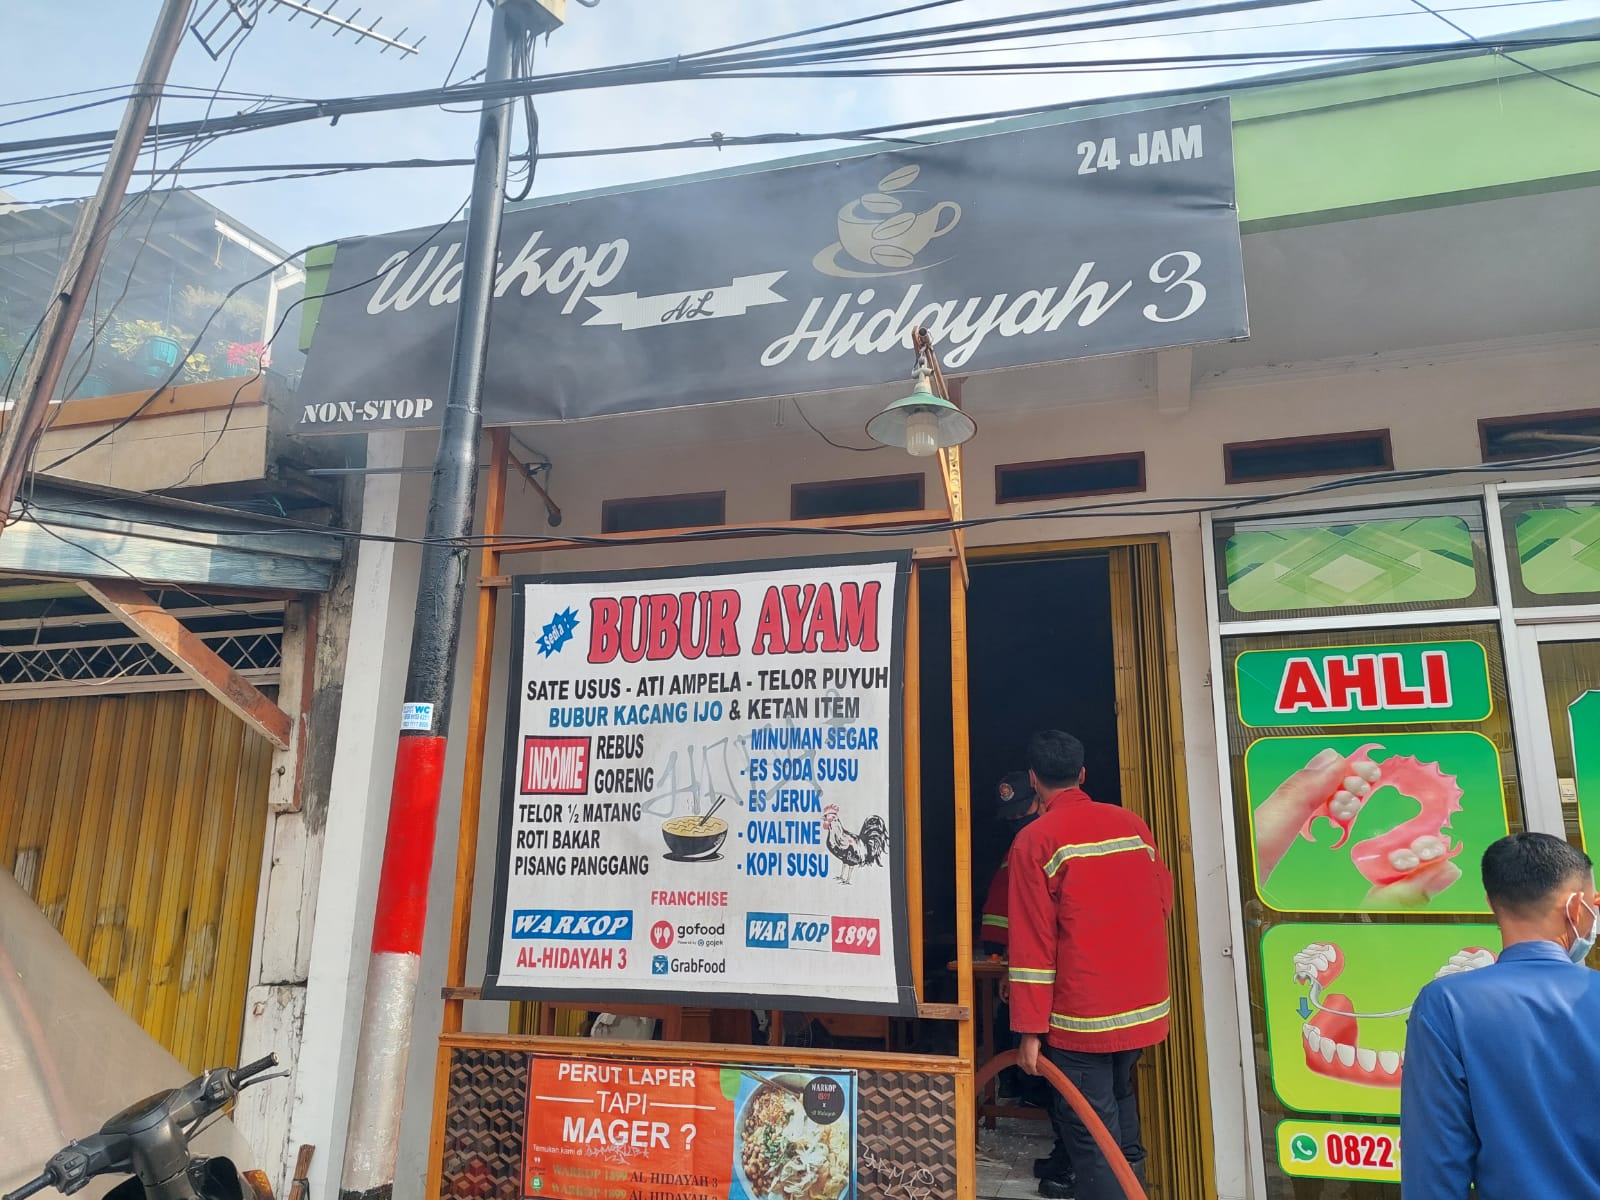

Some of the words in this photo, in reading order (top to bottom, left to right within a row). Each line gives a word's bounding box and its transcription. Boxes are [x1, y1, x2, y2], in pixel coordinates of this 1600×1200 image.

[1077, 140, 1120, 175] 24
[1130, 124, 1203, 167] JAM
[366, 231, 630, 315] Wakop
[661, 290, 714, 324] AL
[760, 262, 1133, 368] Hidayah
[1143, 250, 1207, 323] 3
[300, 398, 432, 423] NON-STOP
[587, 590, 741, 664] BUBUR
[751, 580, 882, 656] AYAM
[527, 680, 569, 700] SATE
[574, 678, 621, 699] USUS
[636, 676, 664, 697] ATI
[669, 672, 742, 696] AMPELA
[758, 668, 817, 691] TELOR
[822, 667, 888, 689] PUYUH
[1276, 652, 1452, 713] AHLI
[415, 705, 430, 714] WC
[549, 706, 608, 728] BUBUR
[614, 702, 688, 726] KACANG
[693, 700, 723, 722] IJO
[729, 699, 741, 721] &
[748, 697, 807, 720] KETAN
[814, 697, 860, 719] ITEM
[596, 734, 644, 760] REBUS
[751, 727, 822, 750] MINUMAN
[827, 727, 878, 750] SEGAR
[528, 746, 584, 791] INDOMIE
[595, 767, 654, 793] GORENG
[749, 758, 768, 781] ES
[772, 758, 813, 781] SODA
[817, 758, 859, 782] SUSU
[519, 804, 563, 823] TELOR
[583, 802, 641, 822] MATANG
[749, 789, 766, 812] ES
[772, 789, 822, 812] JERUK
[516, 830, 548, 849] ROTI
[552, 830, 600, 849] BAKAR
[747, 820, 821, 845] OVALTINE
[515, 856, 566, 876] PISANG
[570, 855, 649, 876] PANGGANG
[746, 852, 782, 876] KOPI
[787, 852, 829, 877] SUSU
[650, 891, 728, 907] FRANCHISE
[515, 915, 629, 936] WARKOP
[677, 922, 725, 938] gofood
[835, 926, 877, 948] 1899
[516, 947, 612, 970] AL-HIDAYAH
[617, 948, 627, 970] 3
[670, 957, 726, 974] GrabFood
[558, 1063, 623, 1085] PERUT
[628, 1068, 696, 1088] LAPER
[811, 1083, 837, 1092] WARKOP
[596, 1090, 647, 1115] TAPI
[562, 1116, 670, 1149] MAGER
[680, 1123, 697, 1151] ?
[533, 1144, 560, 1153] Temukan
[1327, 1133, 1394, 1168] 0822
[552, 1164, 601, 1179] WARKOP
[630, 1171, 648, 1184] AL
[650, 1172, 709, 1187] HIDAYAH
[711, 1177, 718, 1188] 3
[629, 1189, 647, 1200] AL
